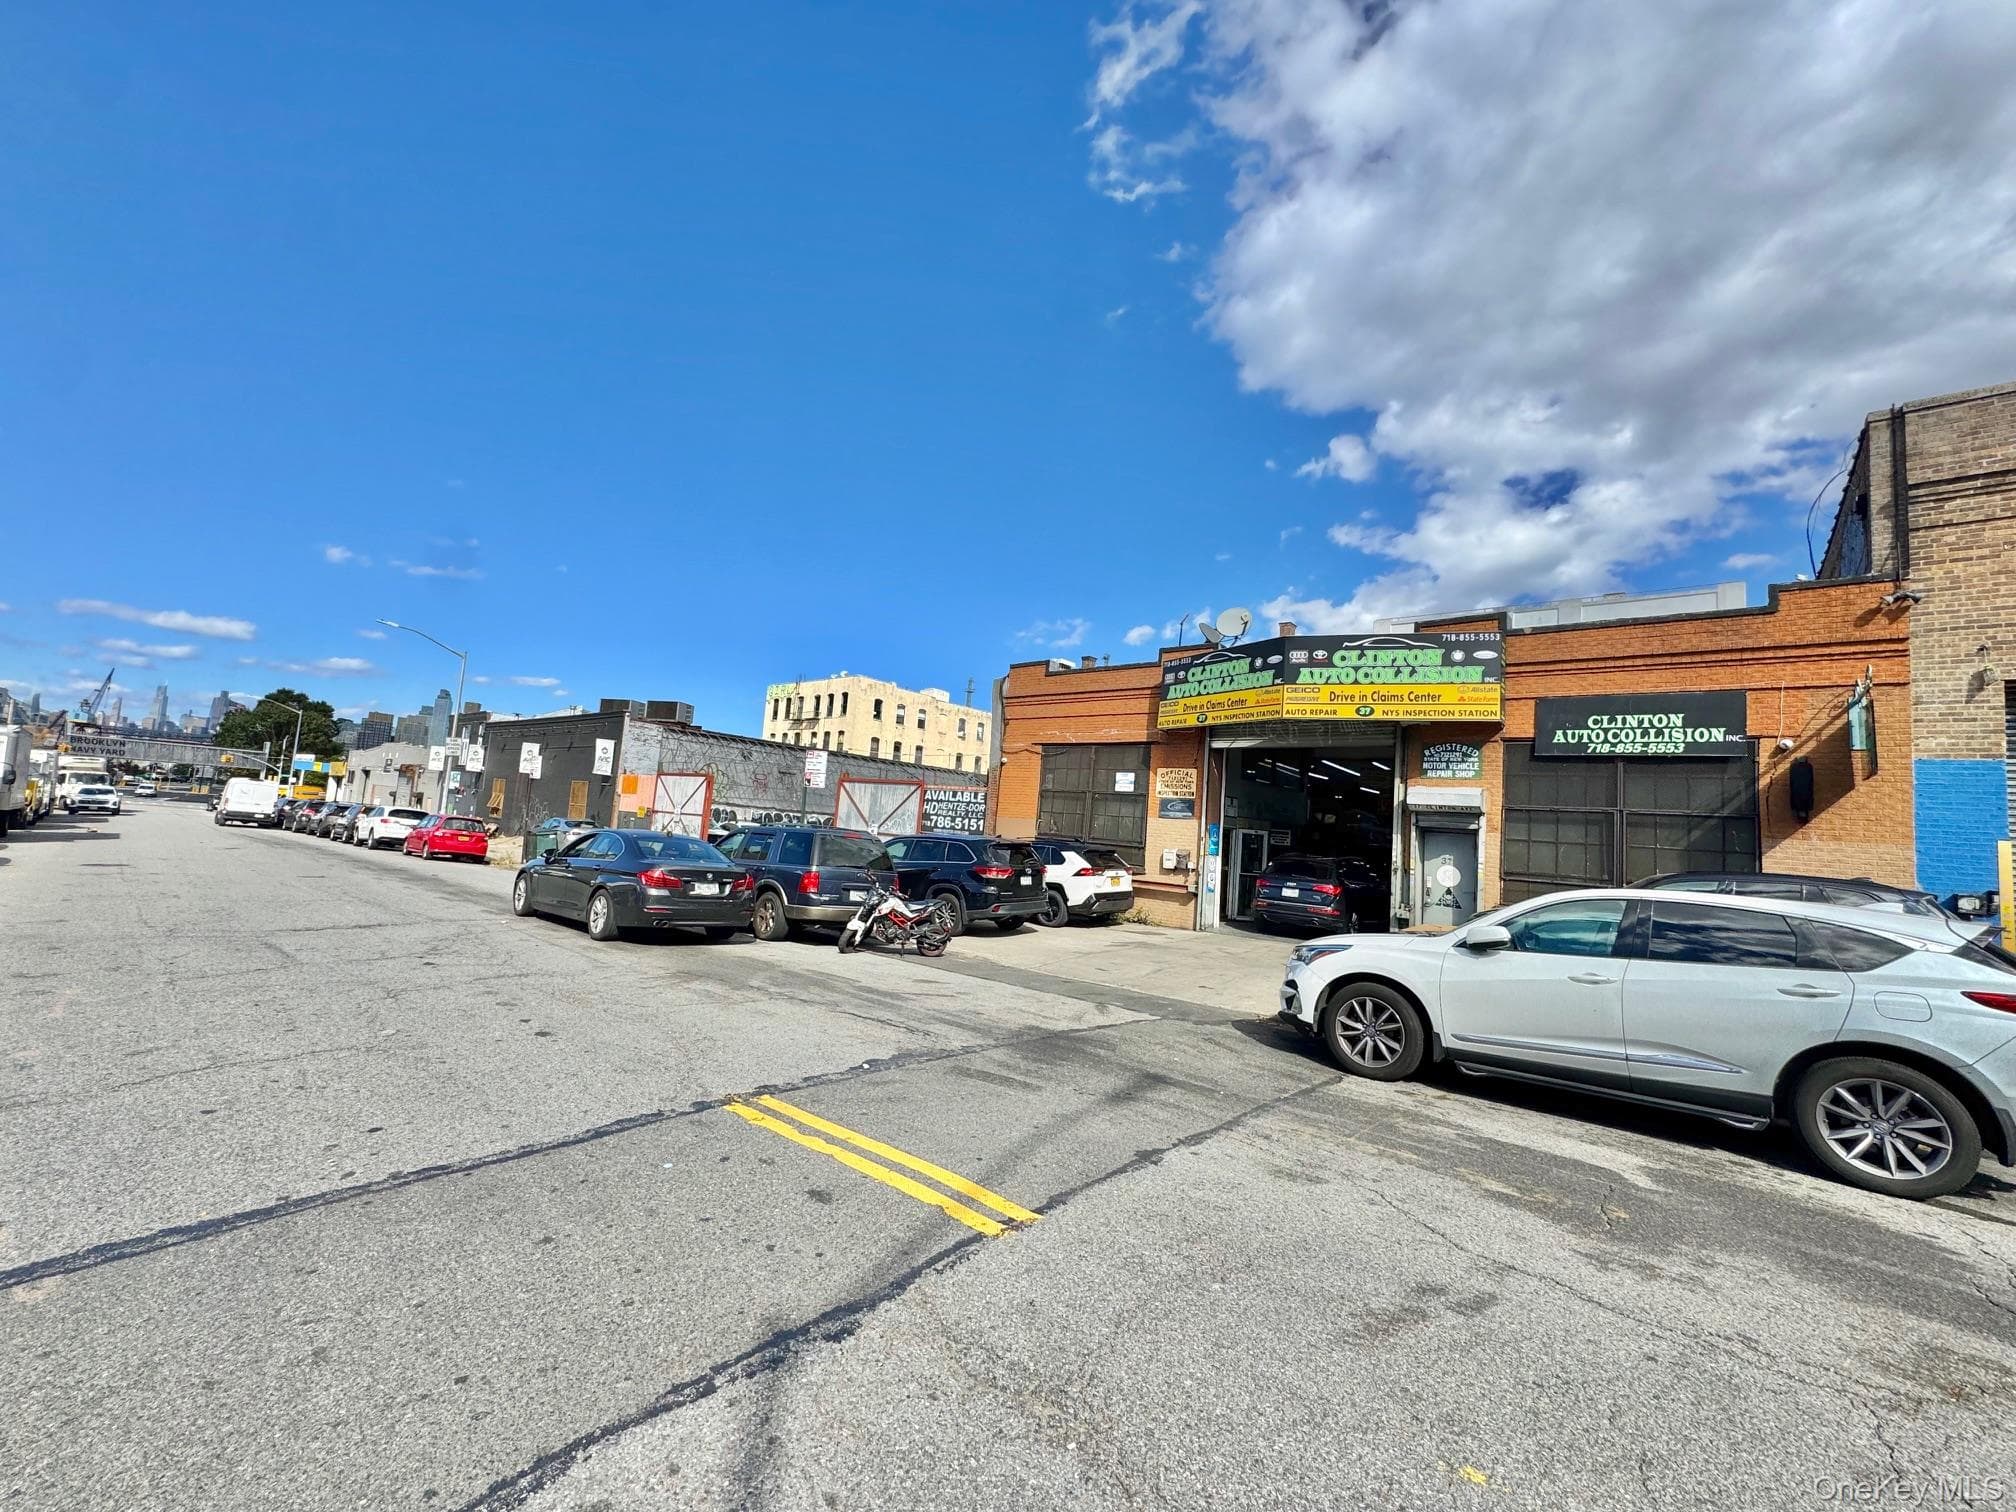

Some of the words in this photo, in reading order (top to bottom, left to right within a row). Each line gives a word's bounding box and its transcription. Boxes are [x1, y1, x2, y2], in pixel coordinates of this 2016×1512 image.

[1442, 633, 1500, 642] 718-855-5553
[1332, 648, 1445, 668] CLINTON
[1187, 657, 1252, 683] CLINTON
[1295, 666, 1357, 685] AUTO
[1356, 666, 1486, 684] COLLISION
[1166, 681, 1200, 700] AUTO
[1199, 669, 1276, 695] COLLISION
[1285, 686, 1321, 694] GEICO
[1329, 690, 1356, 703] Drive
[1358, 690, 1368, 703] in
[1370, 690, 1404, 703] Claims
[1407, 690, 1442, 703] Center
[1182, 703, 1198, 713] Drive
[1199, 701, 1205, 711] in
[1205, 700, 1226, 710] Claims
[1226, 697, 1248, 708] Center
[1222, 711, 1255, 720] INSPECTION
[1255, 709, 1281, 718] STATION
[1309, 708, 1338, 716] REPAIR
[1381, 708, 1400, 717] NYS
[1402, 709, 1456, 717] INSPECTION
[1457, 709, 1498, 718] STATION
[1587, 714, 1684, 729] CLINTON
[70, 736, 126, 747] BROOKLYN
[1552, 729, 1605, 744] AUTO
[1606, 728, 1727, 743] COLLISION
[1726, 734, 1746, 742] INC.
[100, 748, 126, 756] YARD
[1423, 743, 1479, 757] REGISTERED
[1586, 743, 1685, 753] 718-855-5553
[1422, 762, 1447, 770] MOTOR
[1448, 762, 1480, 770] VEHICLE
[1160, 769, 1194, 779] OFFICIAL
[1427, 770, 1453, 778] REPAIR
[1454, 770, 1476, 778] SHOP
[924, 790, 985, 803] AVAILABLE
[923, 801, 938, 814] HD
[938, 802, 986, 812] HENTZE-DOR
[930, 815, 984, 831] 786-5151
